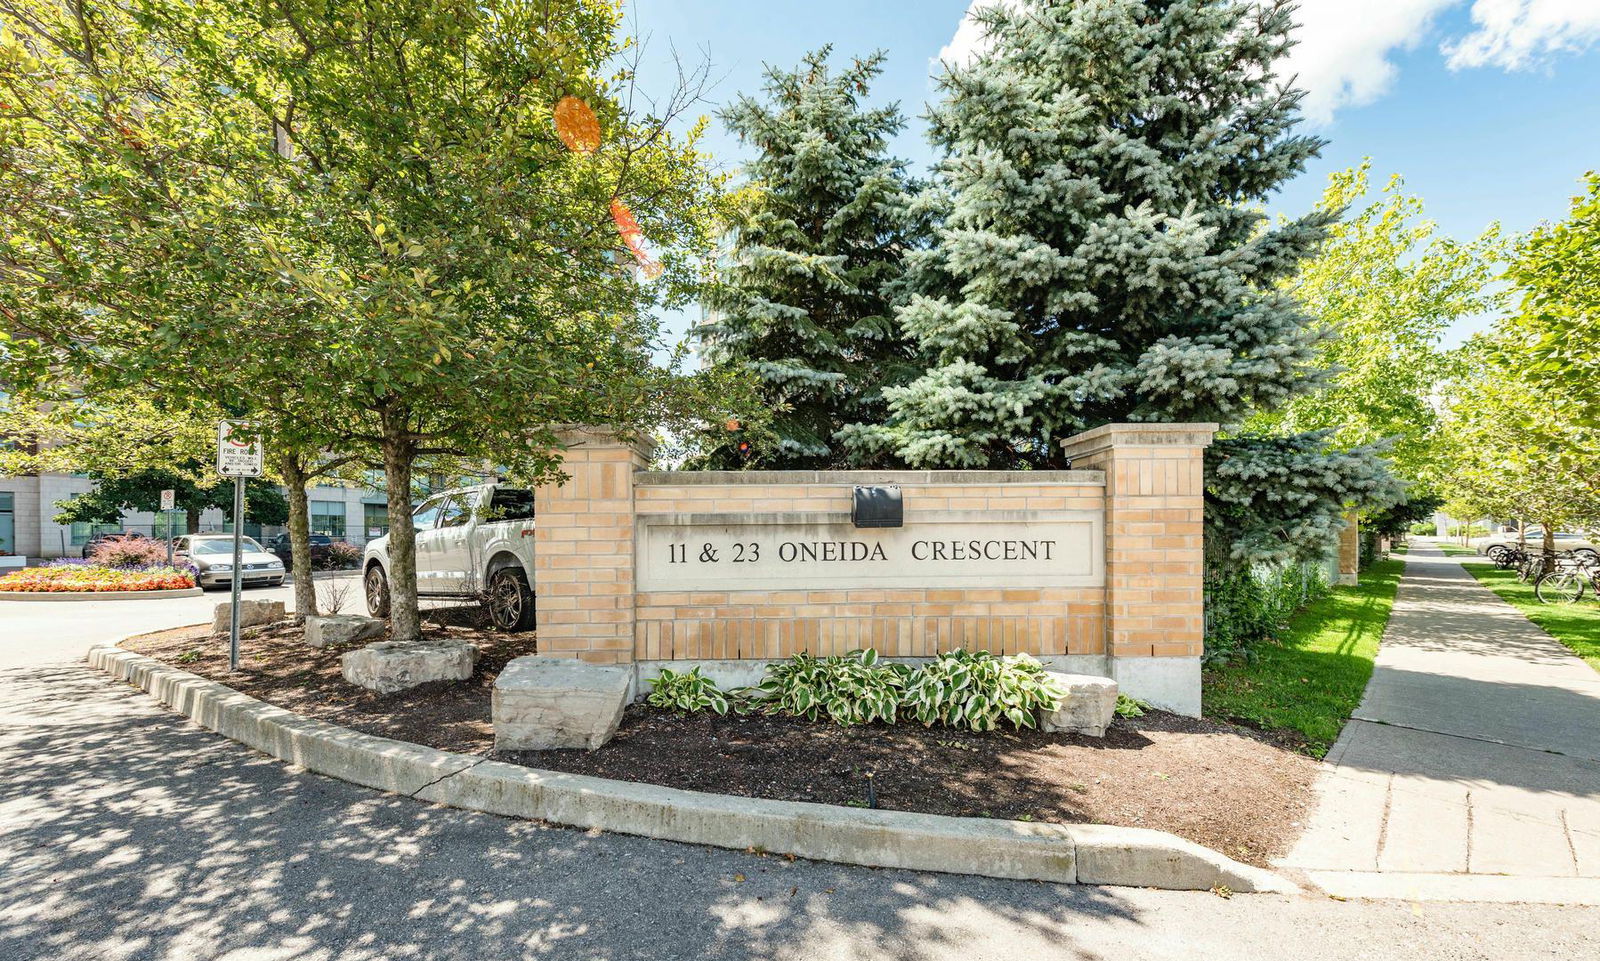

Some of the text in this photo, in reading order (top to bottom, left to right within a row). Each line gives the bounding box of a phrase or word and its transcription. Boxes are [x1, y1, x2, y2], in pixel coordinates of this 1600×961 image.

[669, 540, 1057, 563] 11 & 23 ONEIDA CRESCENT
